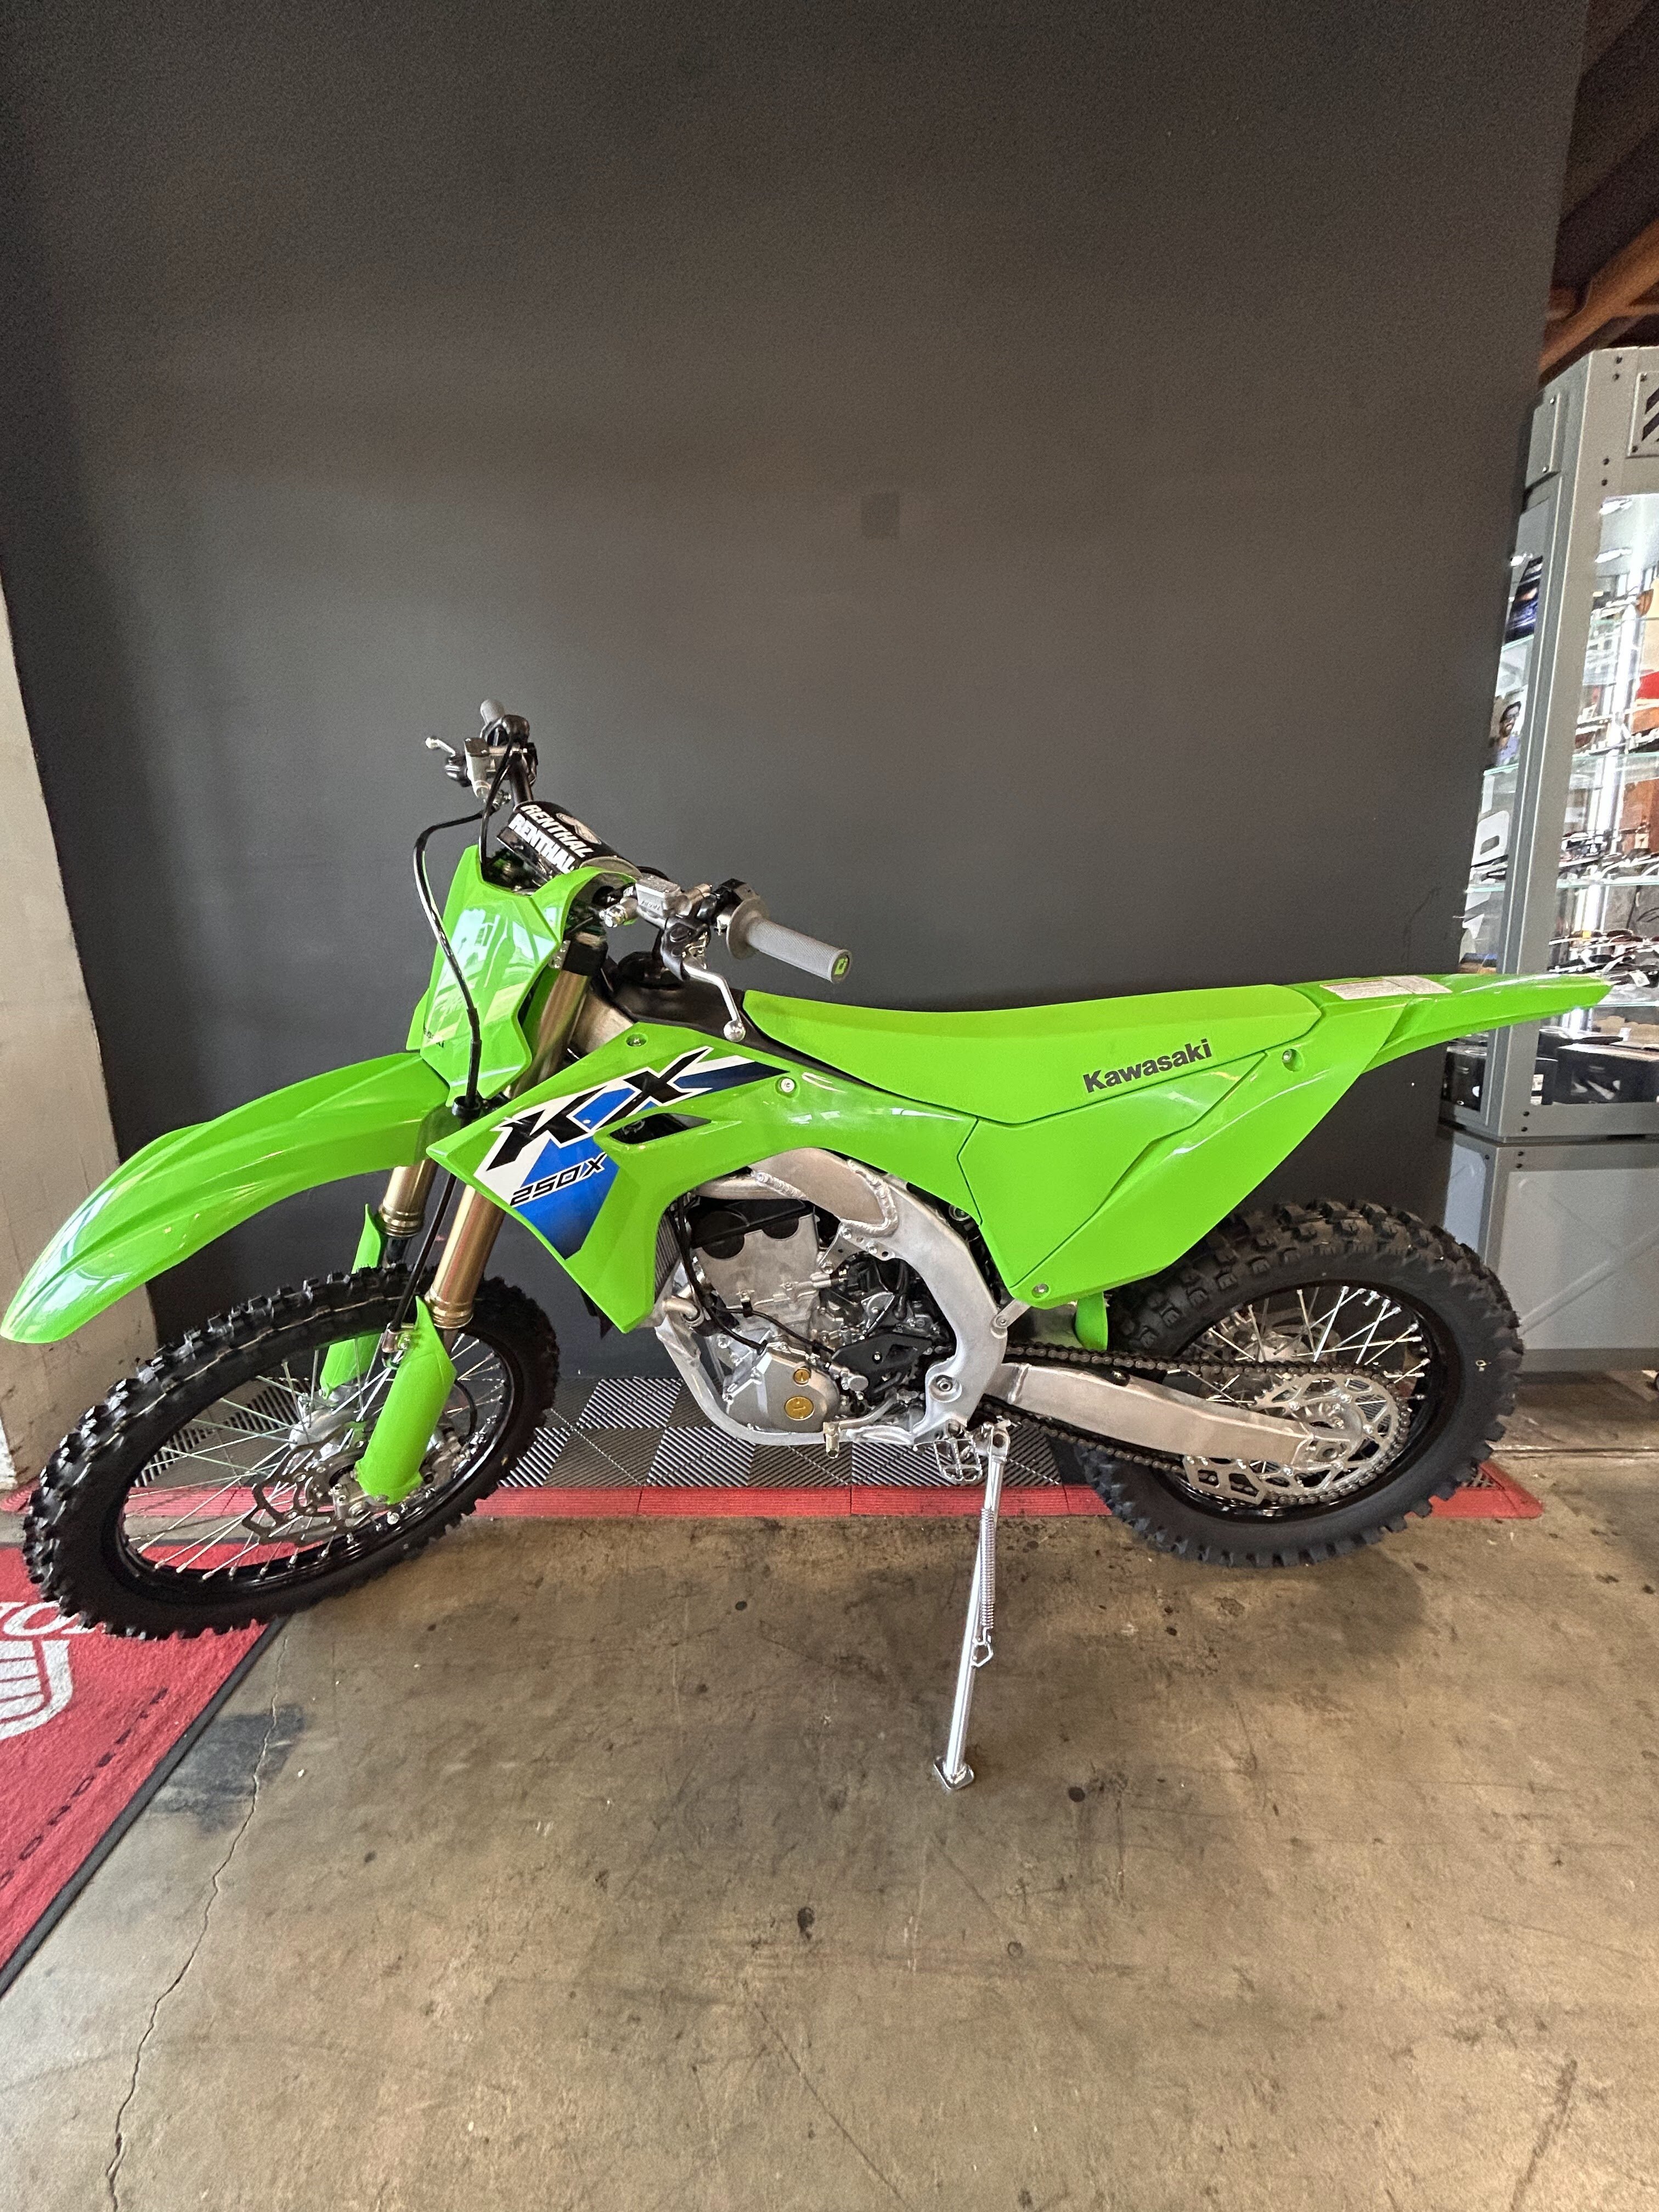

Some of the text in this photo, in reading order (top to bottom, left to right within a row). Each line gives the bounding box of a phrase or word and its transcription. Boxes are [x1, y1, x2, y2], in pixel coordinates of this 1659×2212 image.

[508, 813, 575, 874] RENTHAL
[521, 804, 594, 858] RENTHAL
[1083, 1039, 1212, 1093] Kawasaki
[486, 1047, 712, 1172] KX
[510, 1152, 607, 1206] 250X
